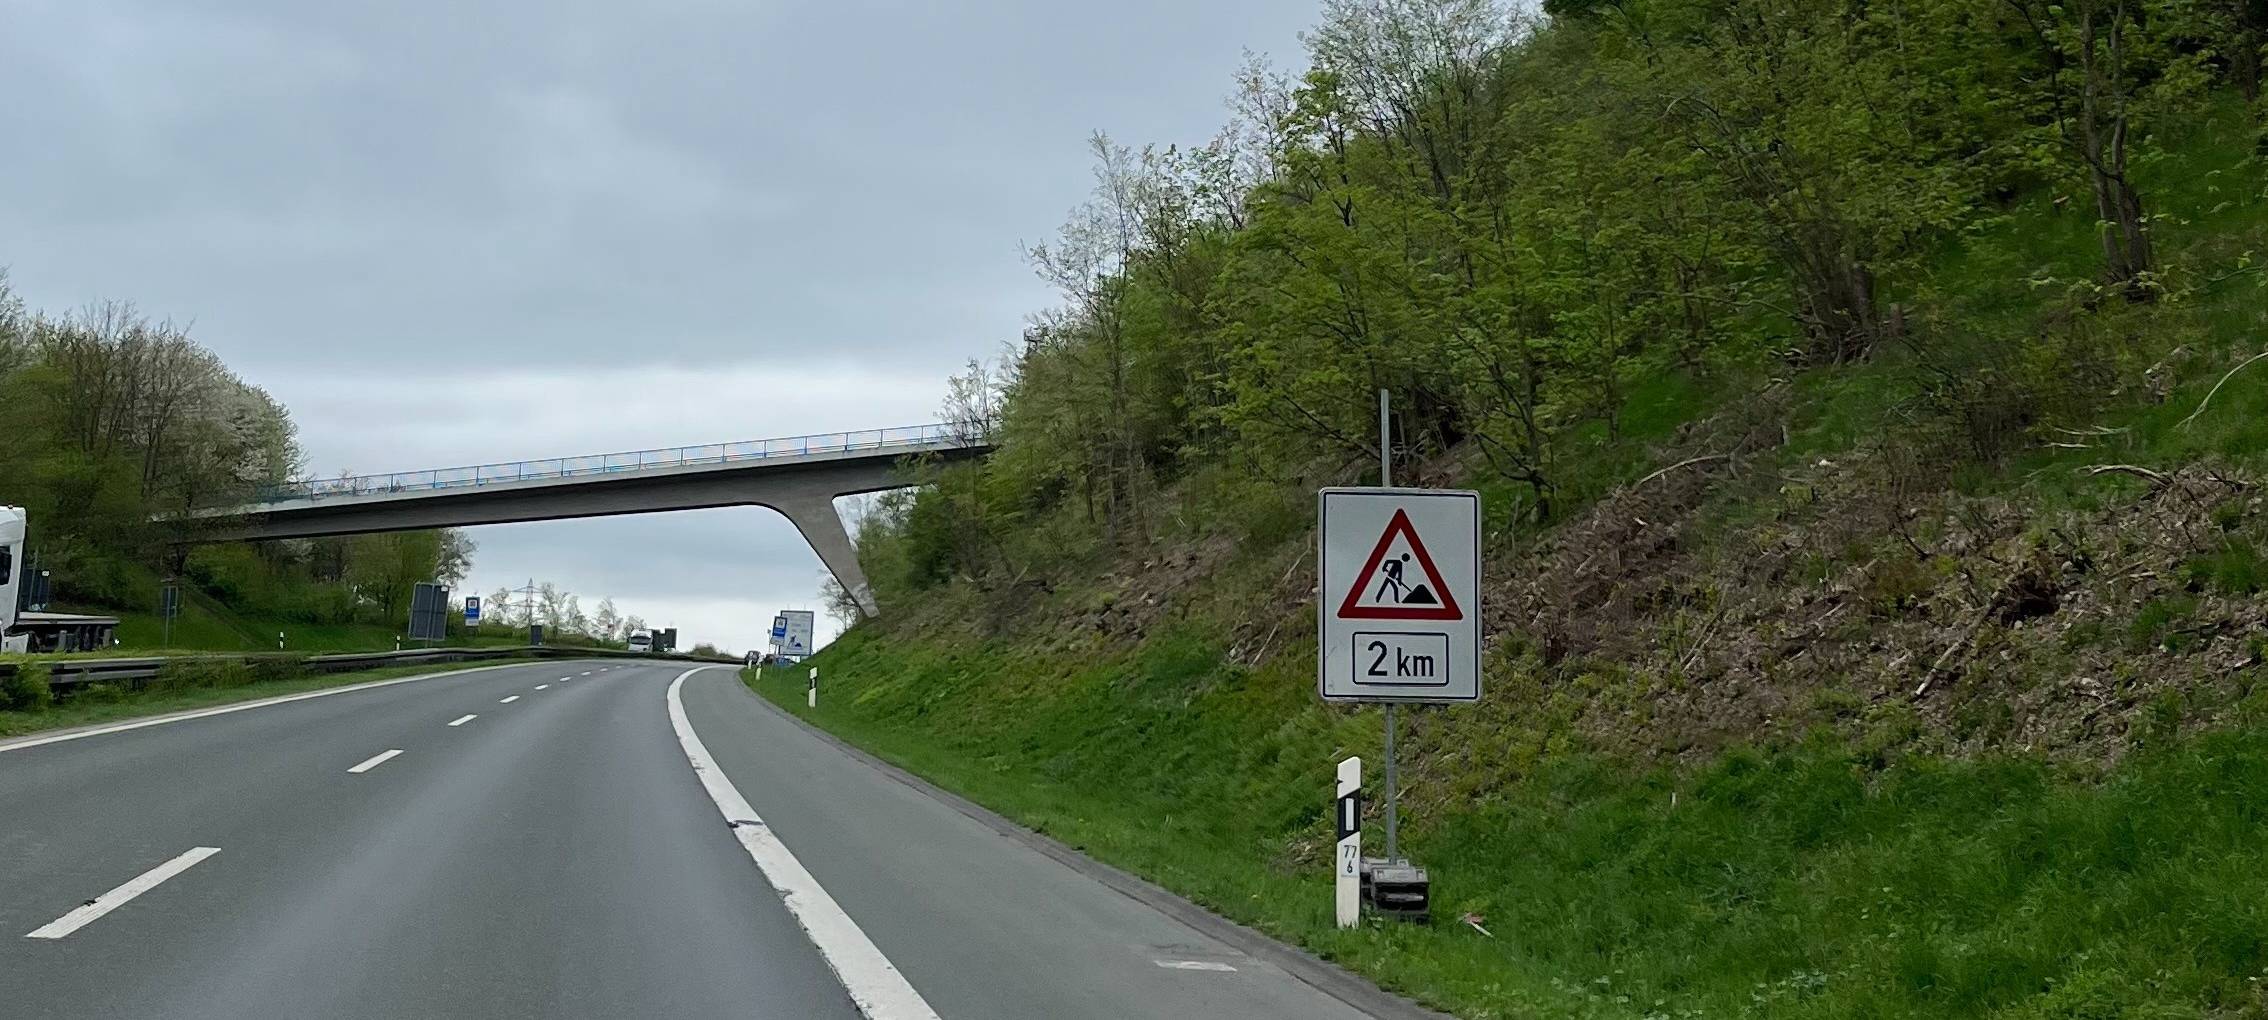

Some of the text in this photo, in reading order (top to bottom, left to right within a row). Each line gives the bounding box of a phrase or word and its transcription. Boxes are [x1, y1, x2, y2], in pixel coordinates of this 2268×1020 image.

[1367, 641, 1434, 676] 2 km
[1344, 845, 1357, 858] 77
[1346, 860, 1353, 873] 6
